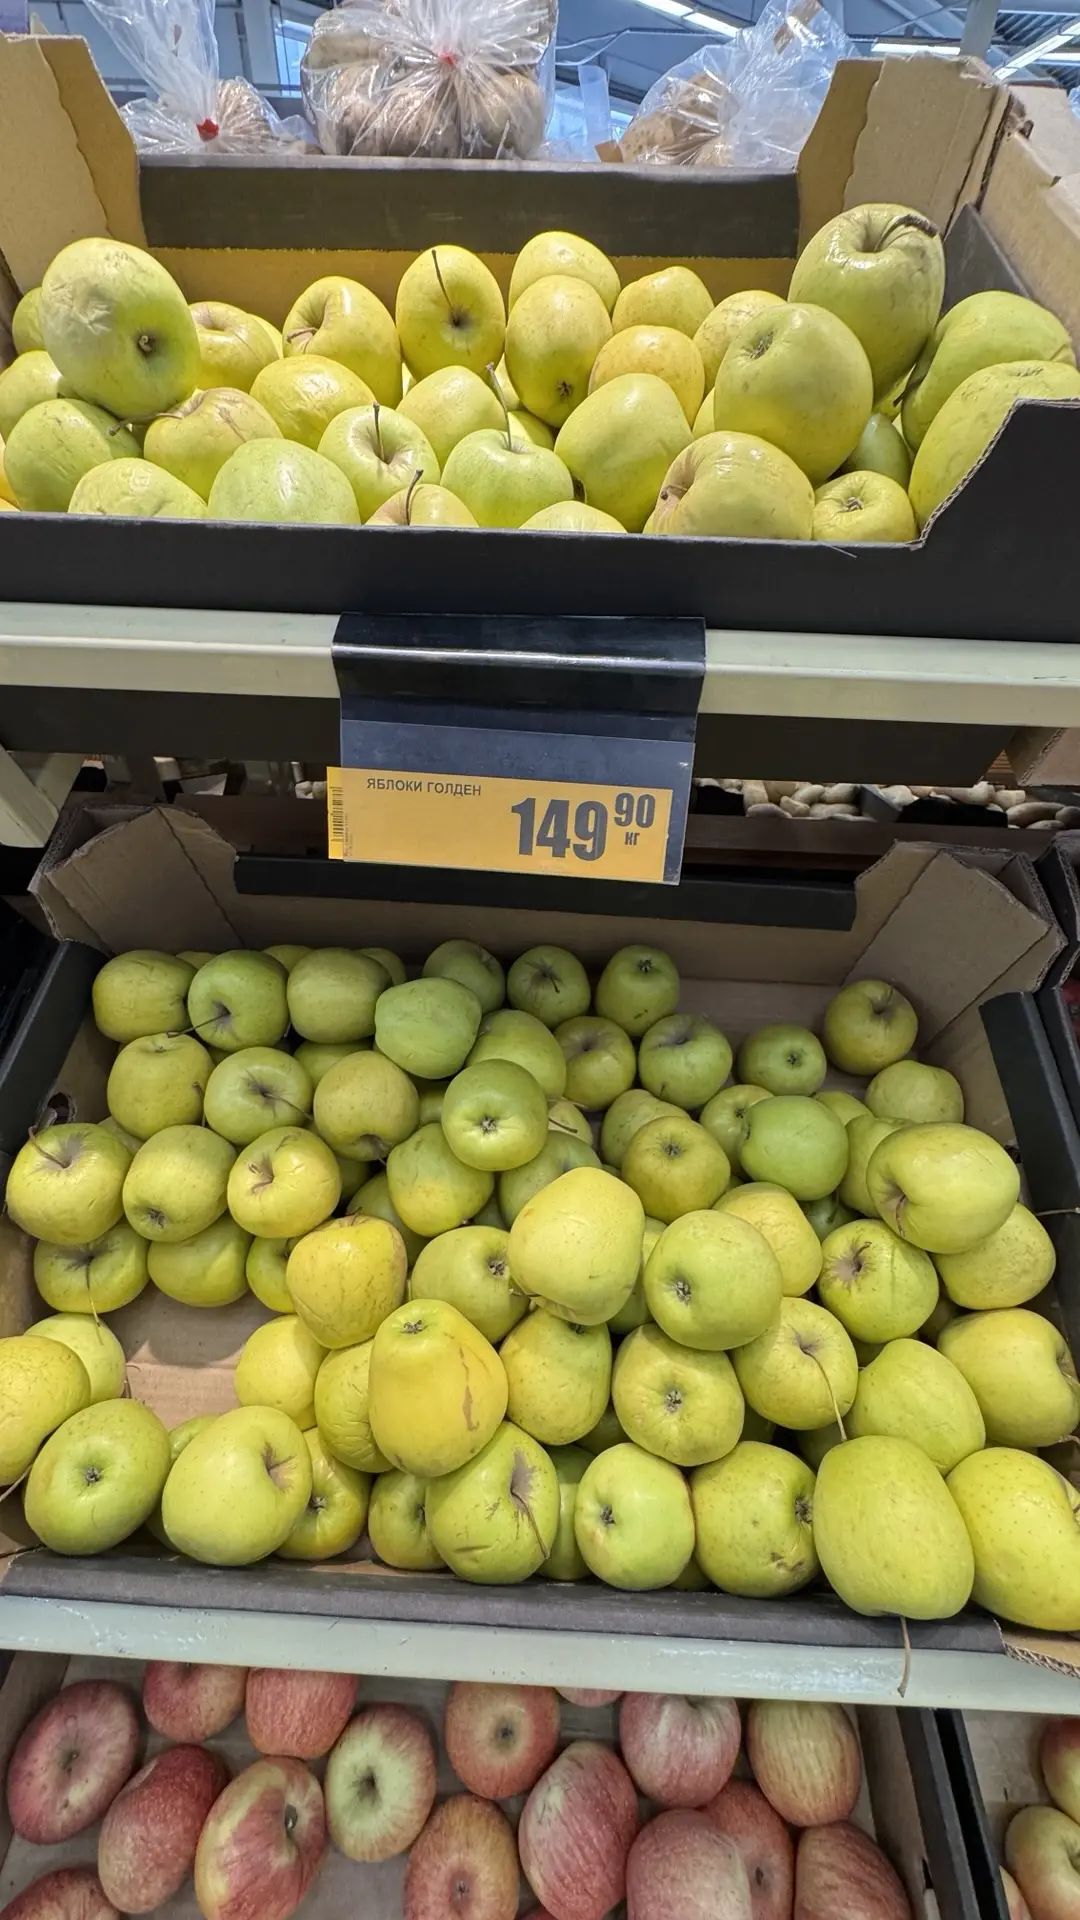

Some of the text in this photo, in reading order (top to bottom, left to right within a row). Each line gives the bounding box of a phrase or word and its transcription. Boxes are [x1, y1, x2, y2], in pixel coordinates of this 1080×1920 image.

[366, 778, 481, 796] ЯБЛОКИ ГОЛДЕН
[511, 792, 656, 861] 149 90
